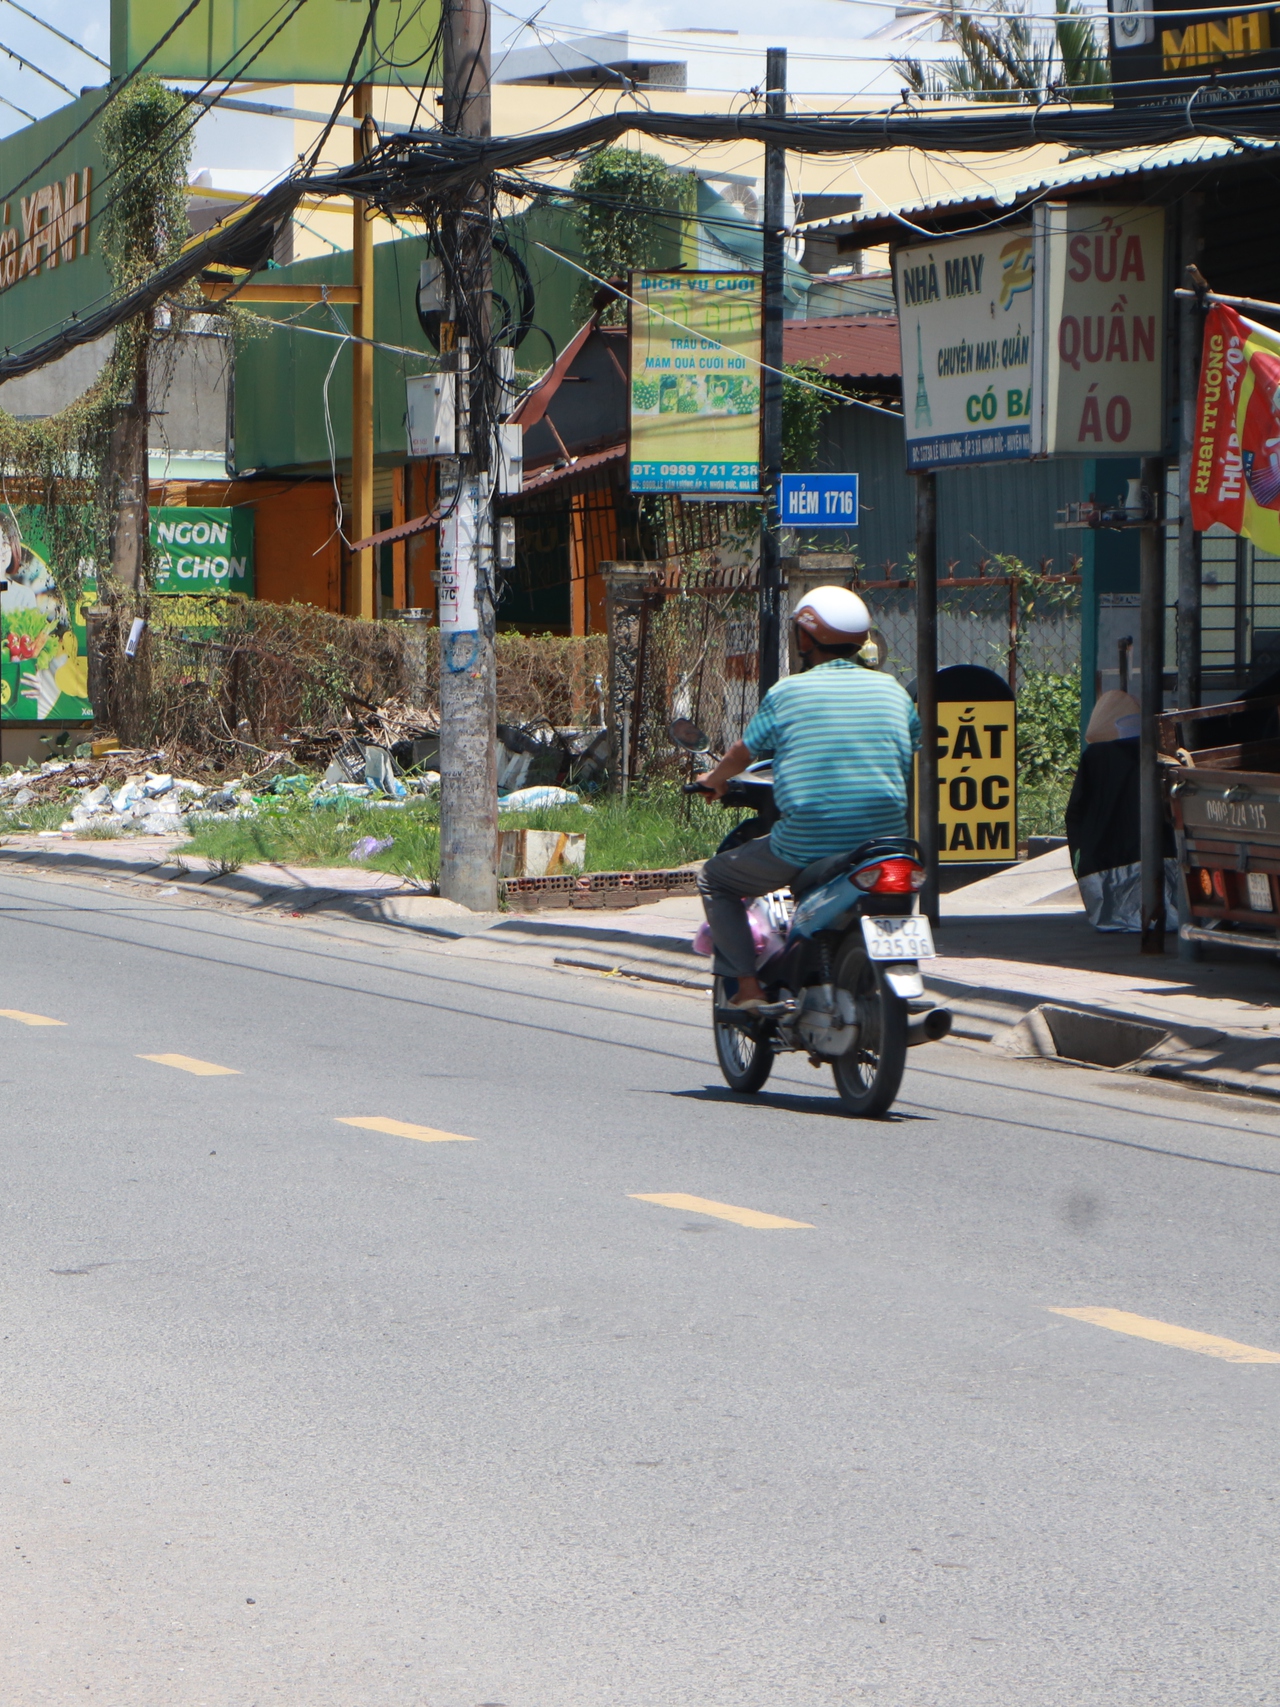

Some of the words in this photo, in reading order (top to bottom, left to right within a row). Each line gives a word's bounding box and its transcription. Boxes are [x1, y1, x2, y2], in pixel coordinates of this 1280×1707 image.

[1162, 11, 1267, 71] MINH
[20, 166, 93, 279] XANH
[1067, 215, 1146, 283] SỬA
[714, 277, 755, 291] CƯỚI
[903, 252, 941, 307] NHÀ
[945, 253, 985, 299] MAY
[1058, 294, 1156, 371] QUẦN
[645, 355, 671, 369] MÂM
[937, 338, 974, 377] CHUYÊN
[976, 339, 1000, 372] MAY:
[966, 384, 998, 423] CÓ
[1077, 382, 1132, 443] ÁO
[632, 464, 656, 475] ĐT:
[659, 464, 696, 476] 0989
[701, 464, 726, 476] 741
[731, 464, 758, 476] 238
[789, 483, 819, 514] HẺM
[824, 491, 853, 514] 1716
[157, 521, 228, 544] NGON
[177, 556, 247, 584] CHỌN
